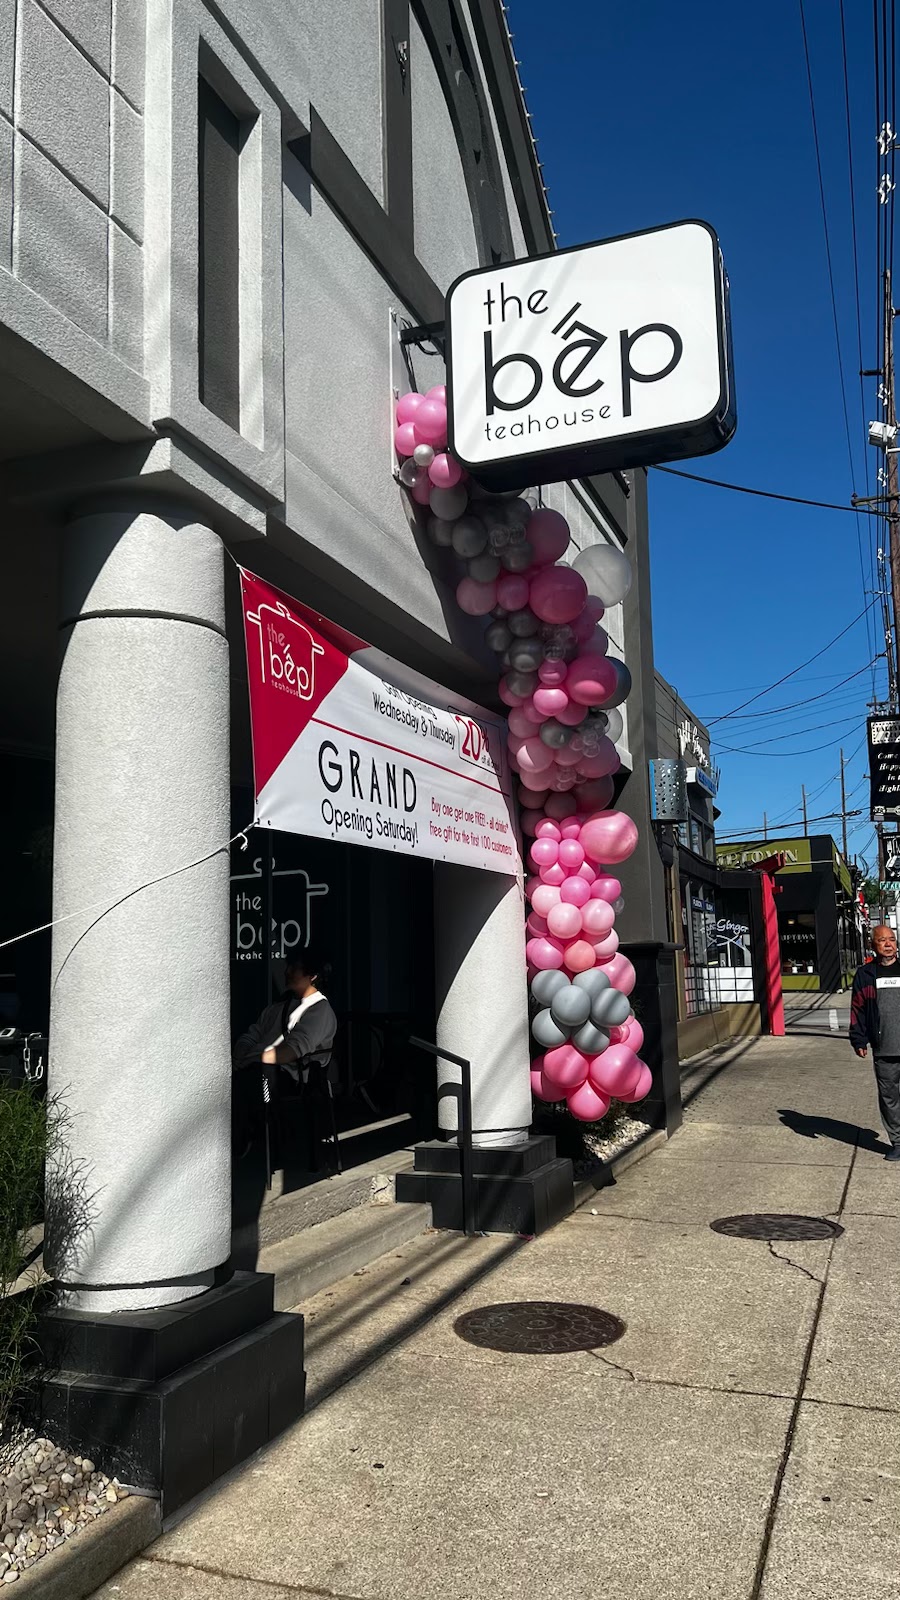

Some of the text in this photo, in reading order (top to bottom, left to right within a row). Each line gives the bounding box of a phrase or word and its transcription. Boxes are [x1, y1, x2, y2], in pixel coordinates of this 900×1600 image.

[483, 282, 549, 325] the
[484, 405, 611, 442] teahouse
[267, 623, 285, 646] the
[372, 691, 456, 750] Wednesday & Thursday
[455, 715, 490, 761] 20%
[318, 740, 417, 813] GRAND
[321, 798, 419, 849] Opening Saturday!
[431, 796, 441, 817] Buy
[442, 804, 453, 817] one
[454, 808, 463, 823] get
[464, 811, 474, 823] one
[429, 820, 513, 856] Free gift for the first 100 customers
[236, 892, 262, 911] the
